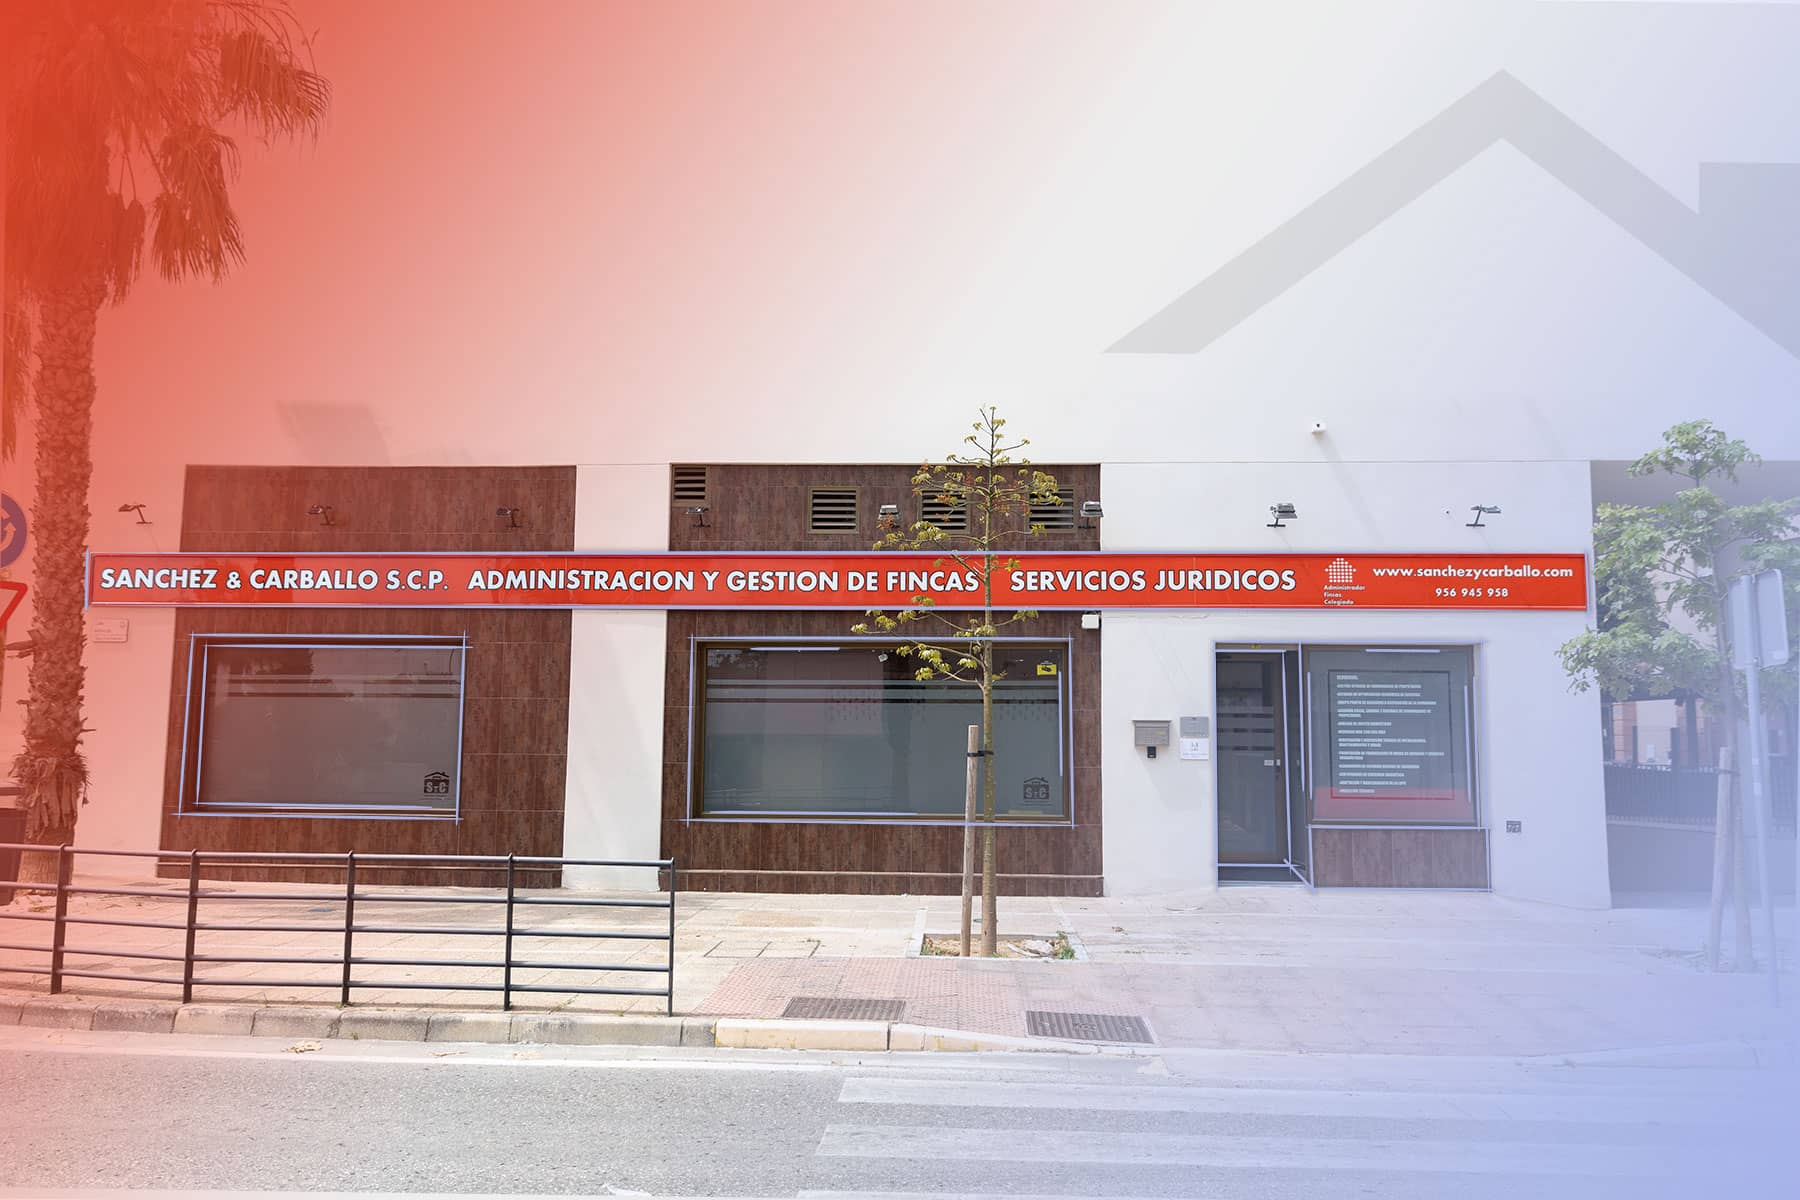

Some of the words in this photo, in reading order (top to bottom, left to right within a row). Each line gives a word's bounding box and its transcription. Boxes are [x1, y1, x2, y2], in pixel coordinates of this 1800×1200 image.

[100, 567, 217, 590] SANCHEZ
[225, 571, 242, 590] &
[249, 568, 379, 590] CARBALLO
[384, 569, 449, 591] S.C.P.
[467, 569, 694, 591] ADMINISTRACION
[702, 570, 720, 591] Y
[726, 570, 839, 592] GESTION
[847, 570, 879, 592] DE
[886, 570, 980, 592] FINCAS
[1010, 569, 1146, 592] SERVICIOS
[1153, 569, 1297, 591] JURIDICOS
[1373, 565, 1574, 580] www.sanchezycarballo.com
[1435, 587, 1457, 598] 956
[1461, 587, 1483, 598] 945
[1486, 588, 1509, 598] 958
